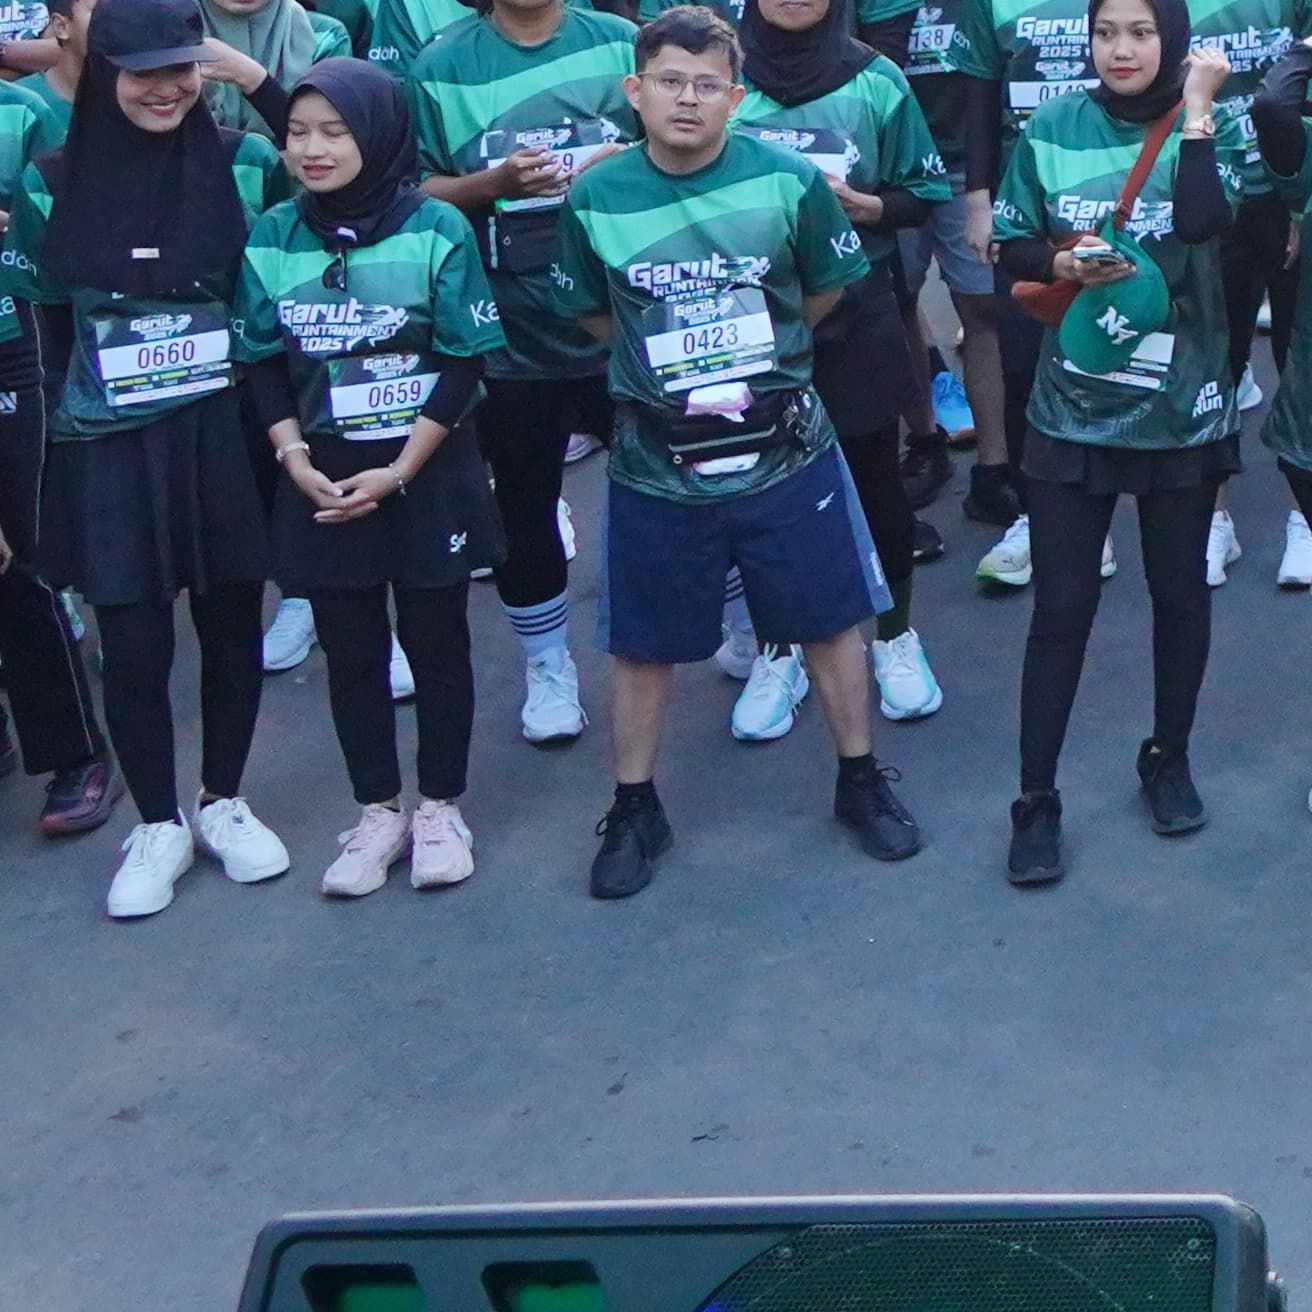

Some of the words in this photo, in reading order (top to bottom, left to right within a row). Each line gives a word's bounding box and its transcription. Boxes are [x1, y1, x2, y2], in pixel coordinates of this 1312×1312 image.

[911, 28, 945, 49] 138
[1017, 17, 1089, 39] Garu
[1040, 44, 1082, 58] 2025
[515, 128, 556, 145] Garut
[760, 128, 800, 143] Garut
[628, 252, 729, 286] Garut
[278, 297, 363, 326] Garut
[674, 299, 720, 318] Garut
[130, 314, 175, 333] Garut
[291, 323, 399, 339] RUNTAINMENT
[1096, 305, 1139, 346] NY
[299, 336, 346, 352] 2025
[682, 323, 740, 355] 0423
[137, 340, 197, 370] 0660
[362, 355, 404, 372] Garut
[368, 380, 422, 409] 0659
[1192, 395, 1224, 418] Run
